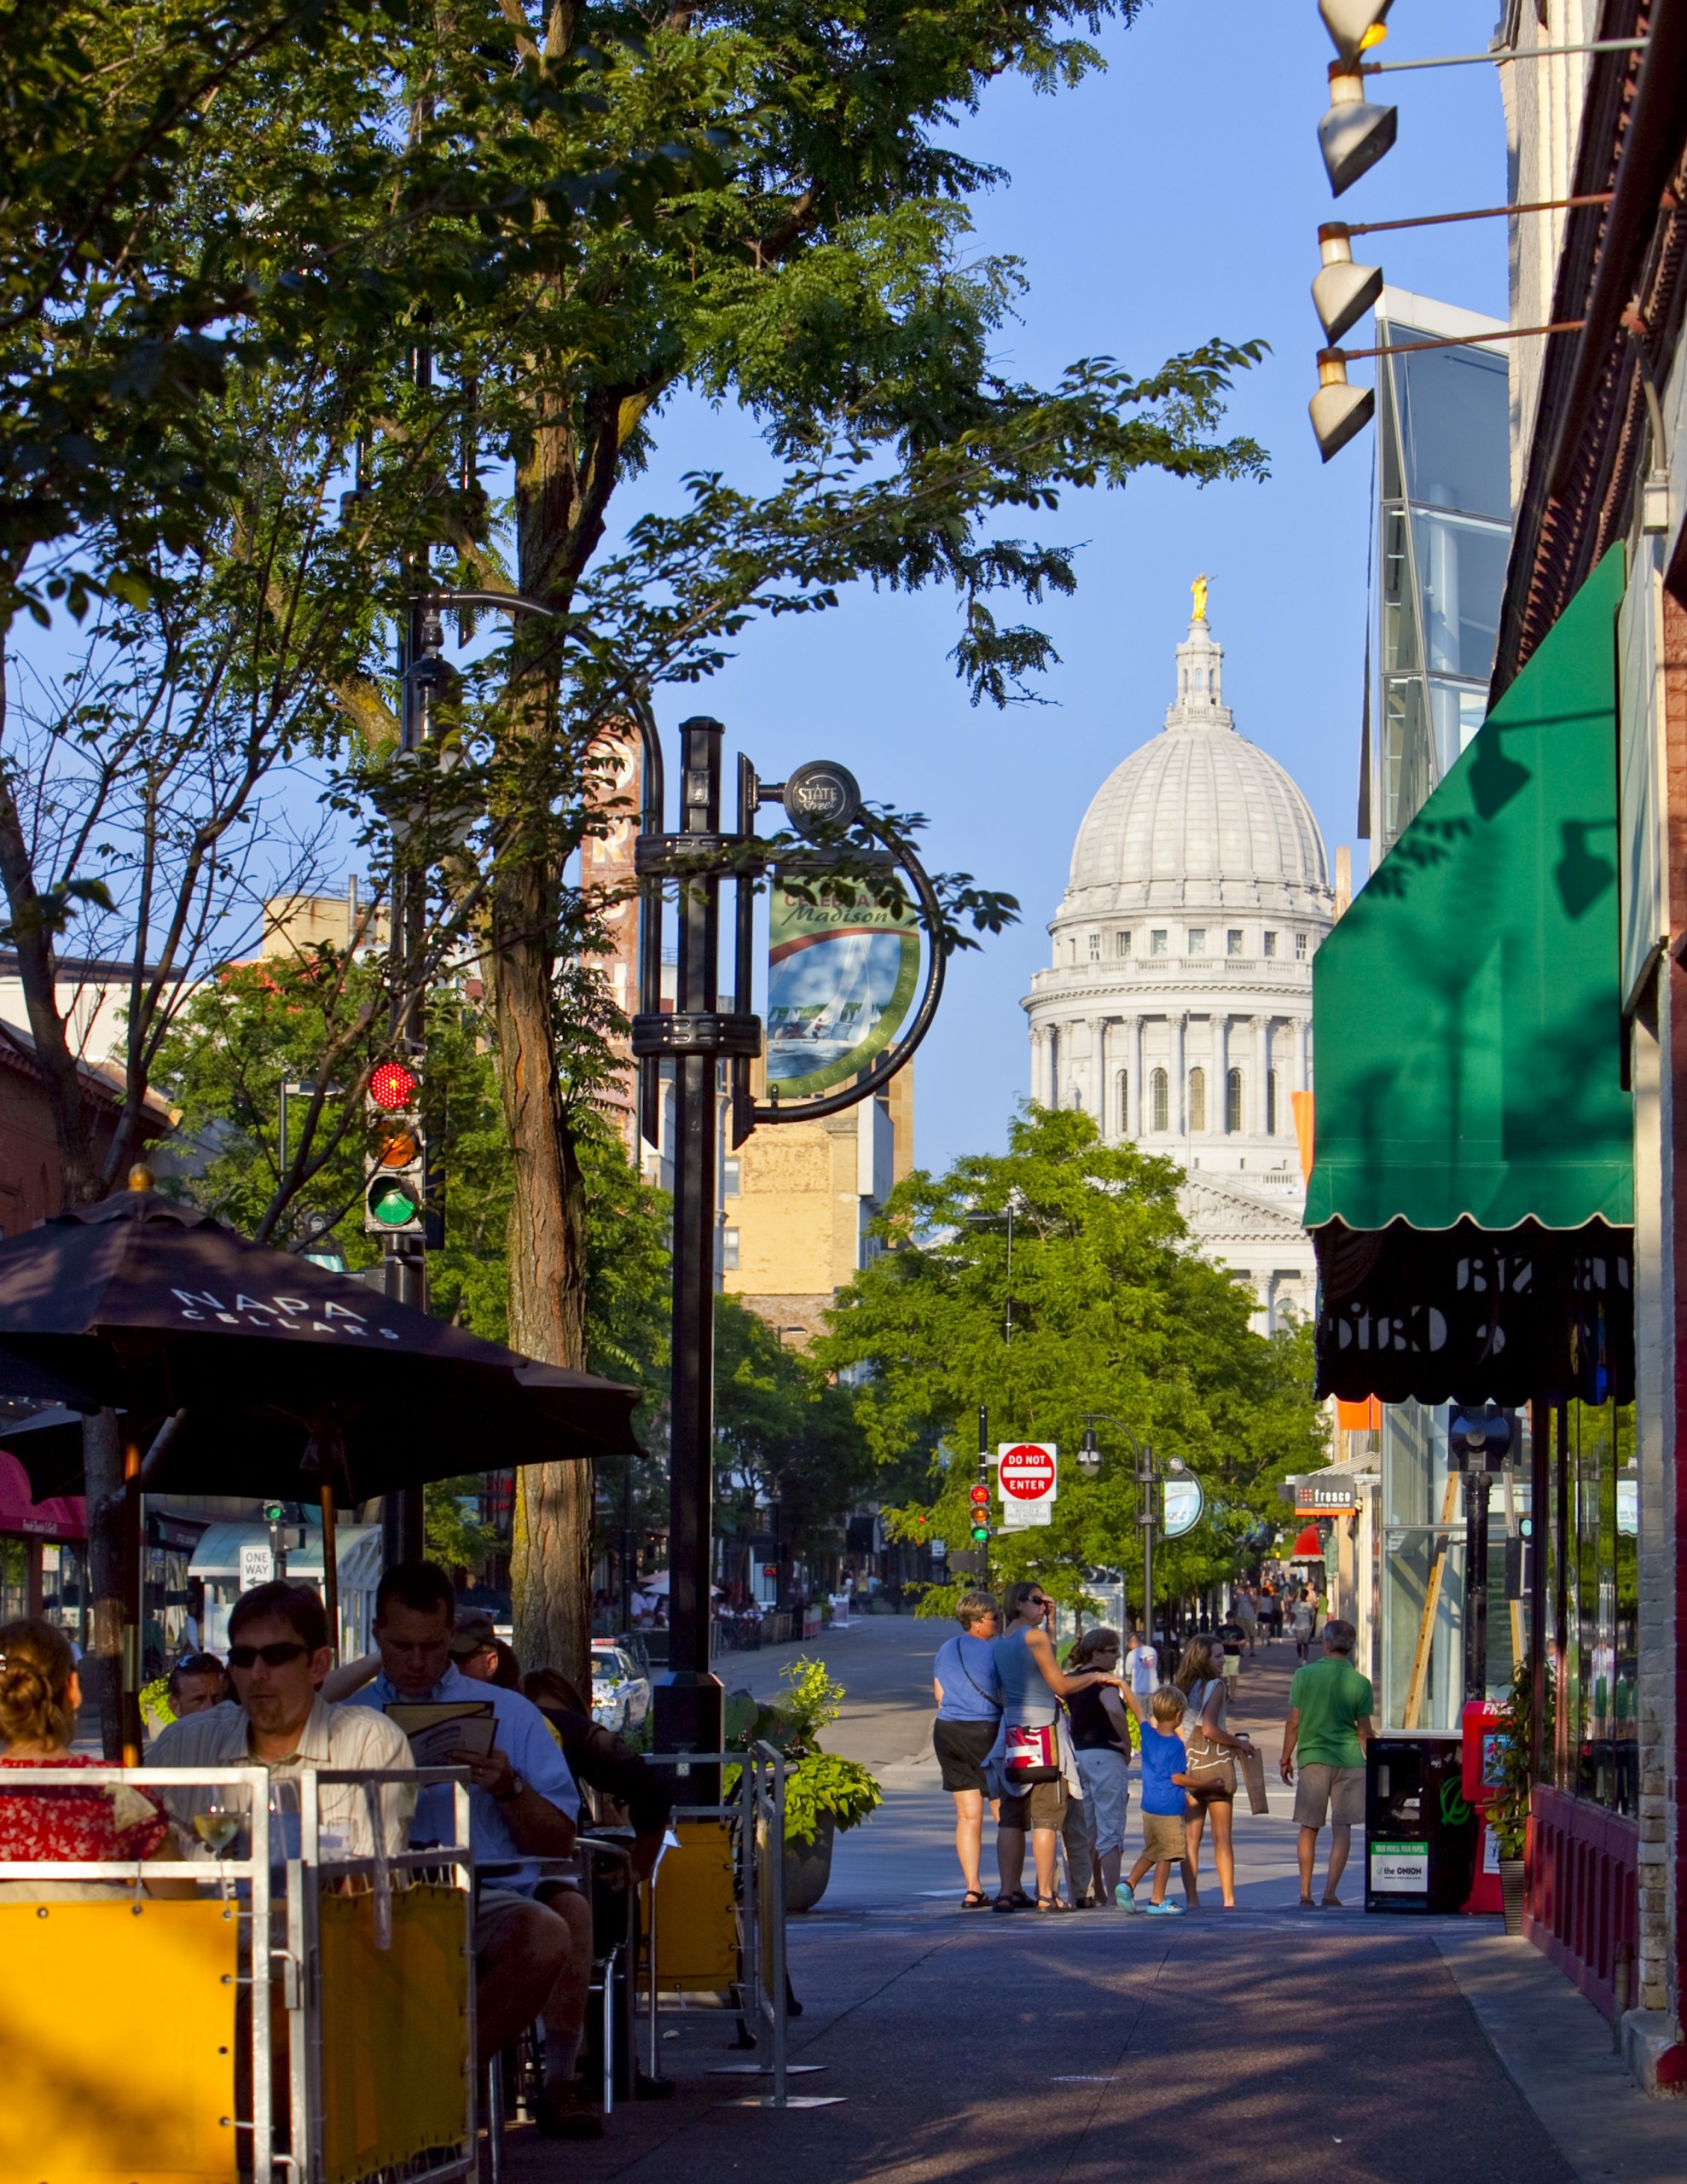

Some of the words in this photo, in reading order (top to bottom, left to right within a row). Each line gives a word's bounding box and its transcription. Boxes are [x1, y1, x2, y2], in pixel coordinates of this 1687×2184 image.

[798, 784, 838, 803] STATE
[803, 799, 836, 811] Street
[781, 904, 888, 926] Madison
[797, 1027, 888, 1091] CELEBRATE
[889, 942, 915, 1018] SUMMER
[171, 1288, 368, 1322] NAPA
[182, 1310, 399, 1339] CELLARS
[1008, 1455, 1023, 1465] DO
[1025, 1455, 1046, 1465] NOT
[1010, 1480, 1045, 1490] ENTER
[1314, 1489, 1351, 1502] fresco
[246, 1553, 268, 1562] ONE
[245, 1565, 269, 1574] WAY
[1383, 1867, 1394, 1875] the
[1397, 1867, 1422, 1875] ONION
